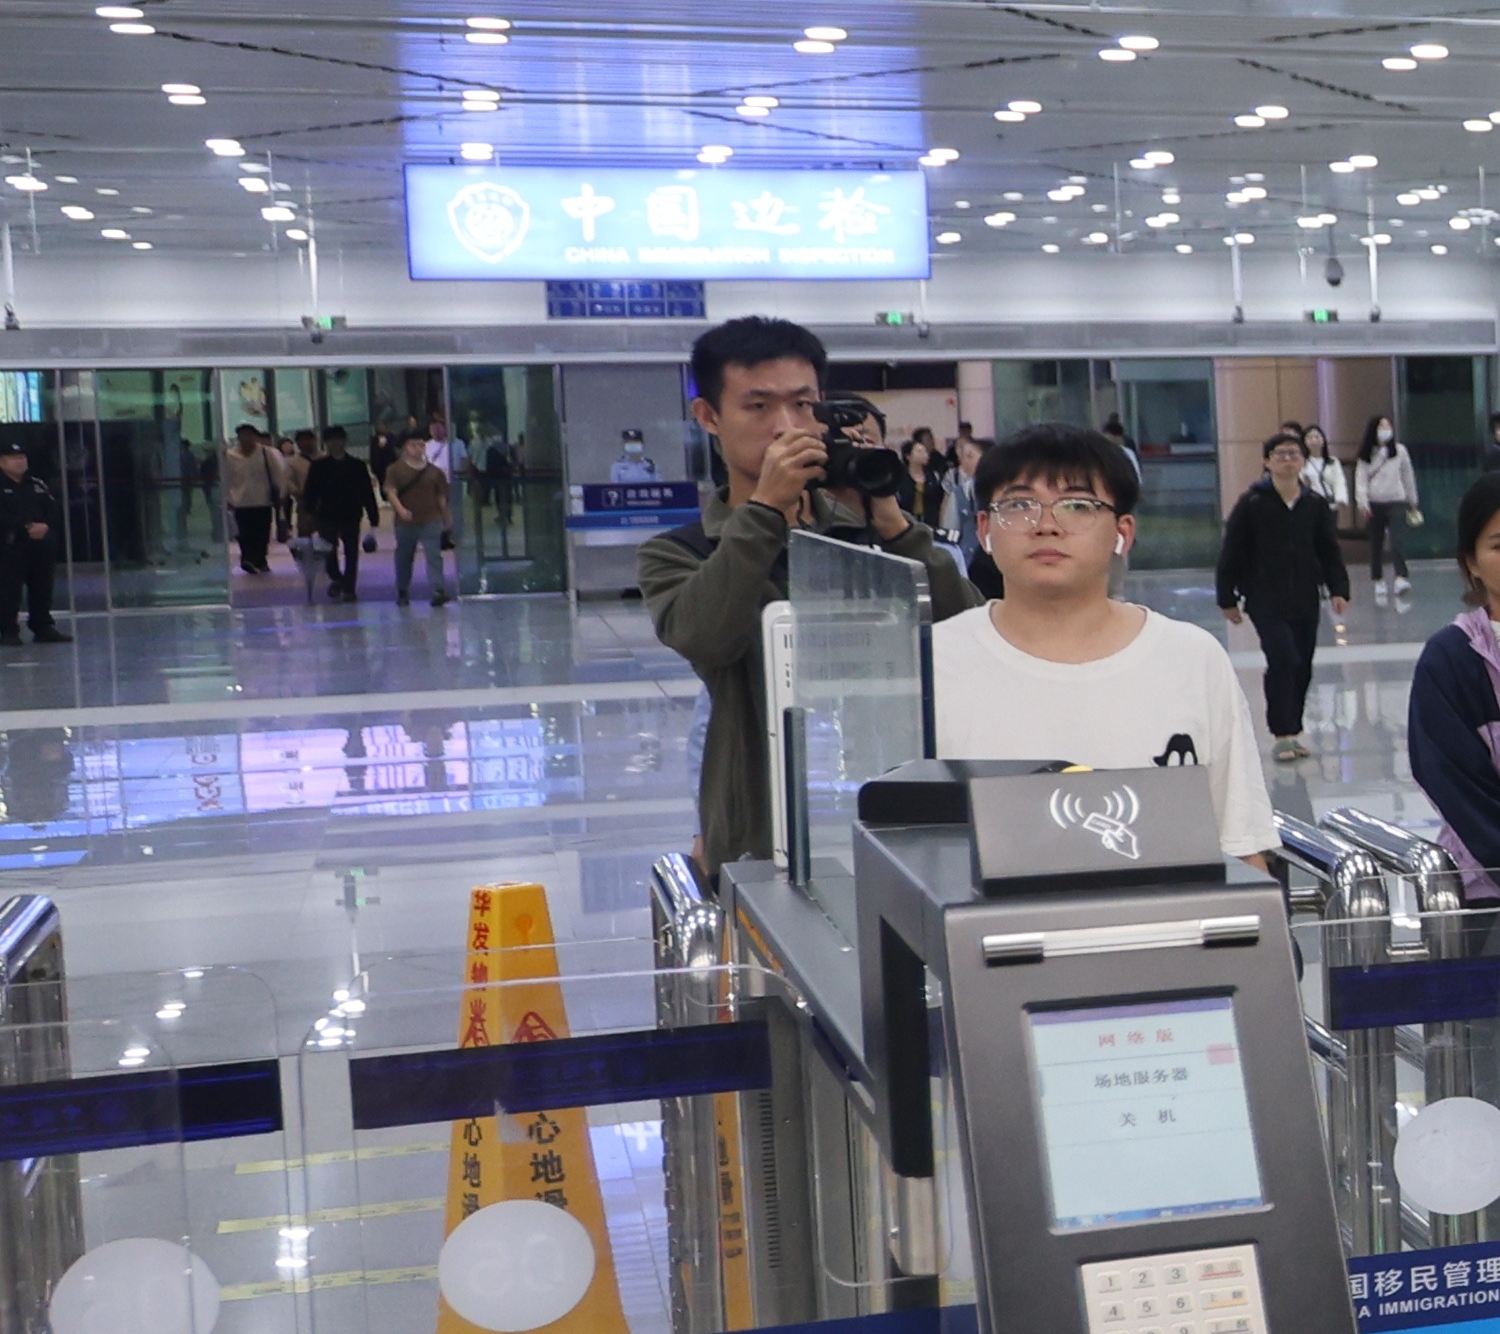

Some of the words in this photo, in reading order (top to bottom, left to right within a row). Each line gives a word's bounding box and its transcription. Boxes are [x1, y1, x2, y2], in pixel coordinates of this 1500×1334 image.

[561, 183, 892, 243] 中国边检
[1094, 1067, 1188, 1089] 场地服务器
[1107, 1276, 1113, 1287] 1
[1138, 1272, 1147, 1284] 2
[1172, 1268, 1181, 1280] 3
[1109, 1306, 1118, 1317] 4
[1142, 1302, 1151, 1313] 5
[1176, 1298, 1185, 1309] 6
[1379, 1288, 1500, 1316] IMMIGRATION
